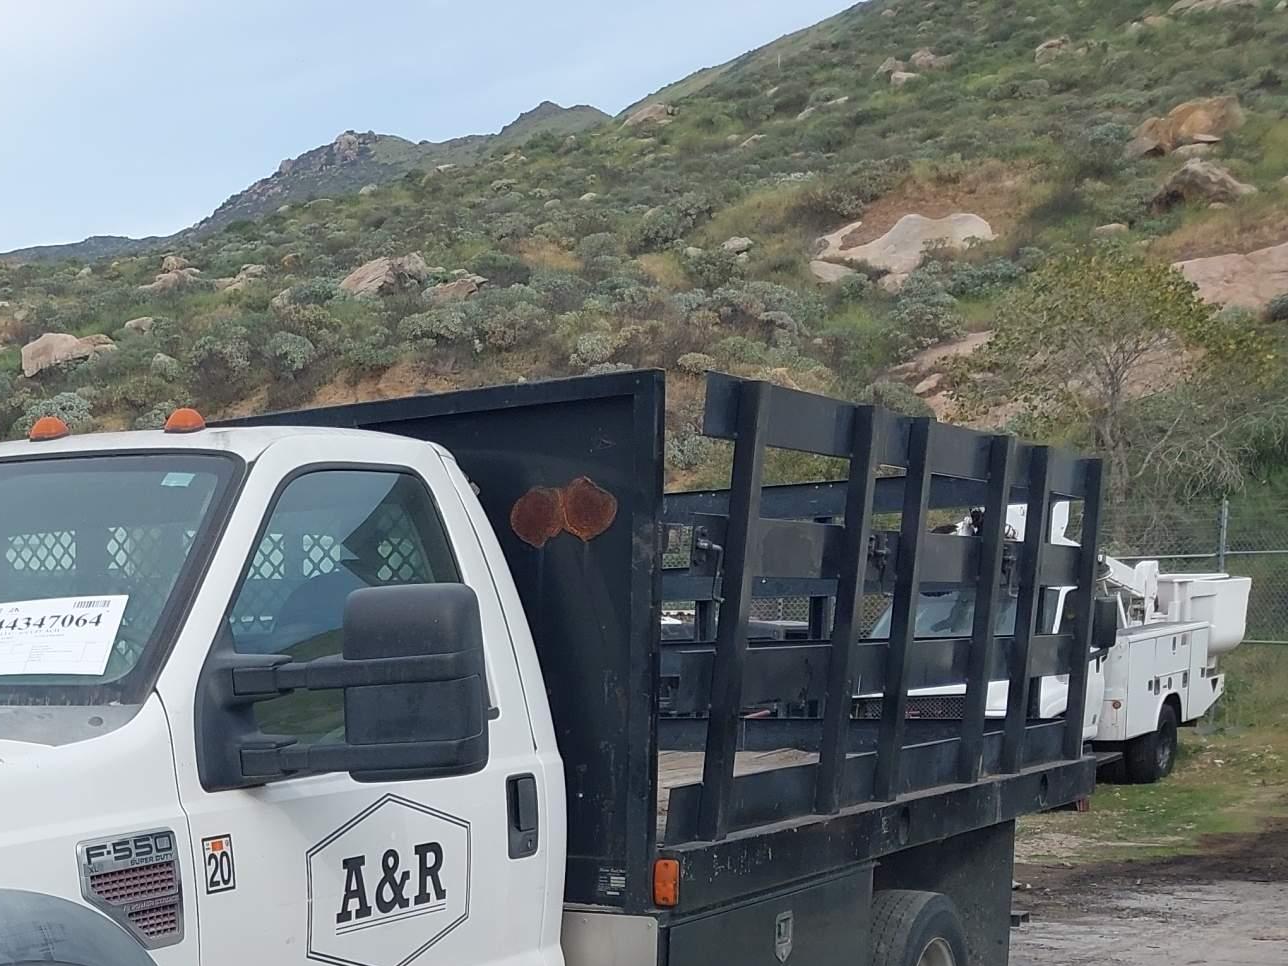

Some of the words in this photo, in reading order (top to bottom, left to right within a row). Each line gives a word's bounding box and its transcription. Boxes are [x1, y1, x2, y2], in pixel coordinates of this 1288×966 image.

[129, 856, 155, 867] SUPER
[154, 852, 175, 863] DUTY
[207, 850, 232, 888] 20
[335, 841, 447, 924] A&R
